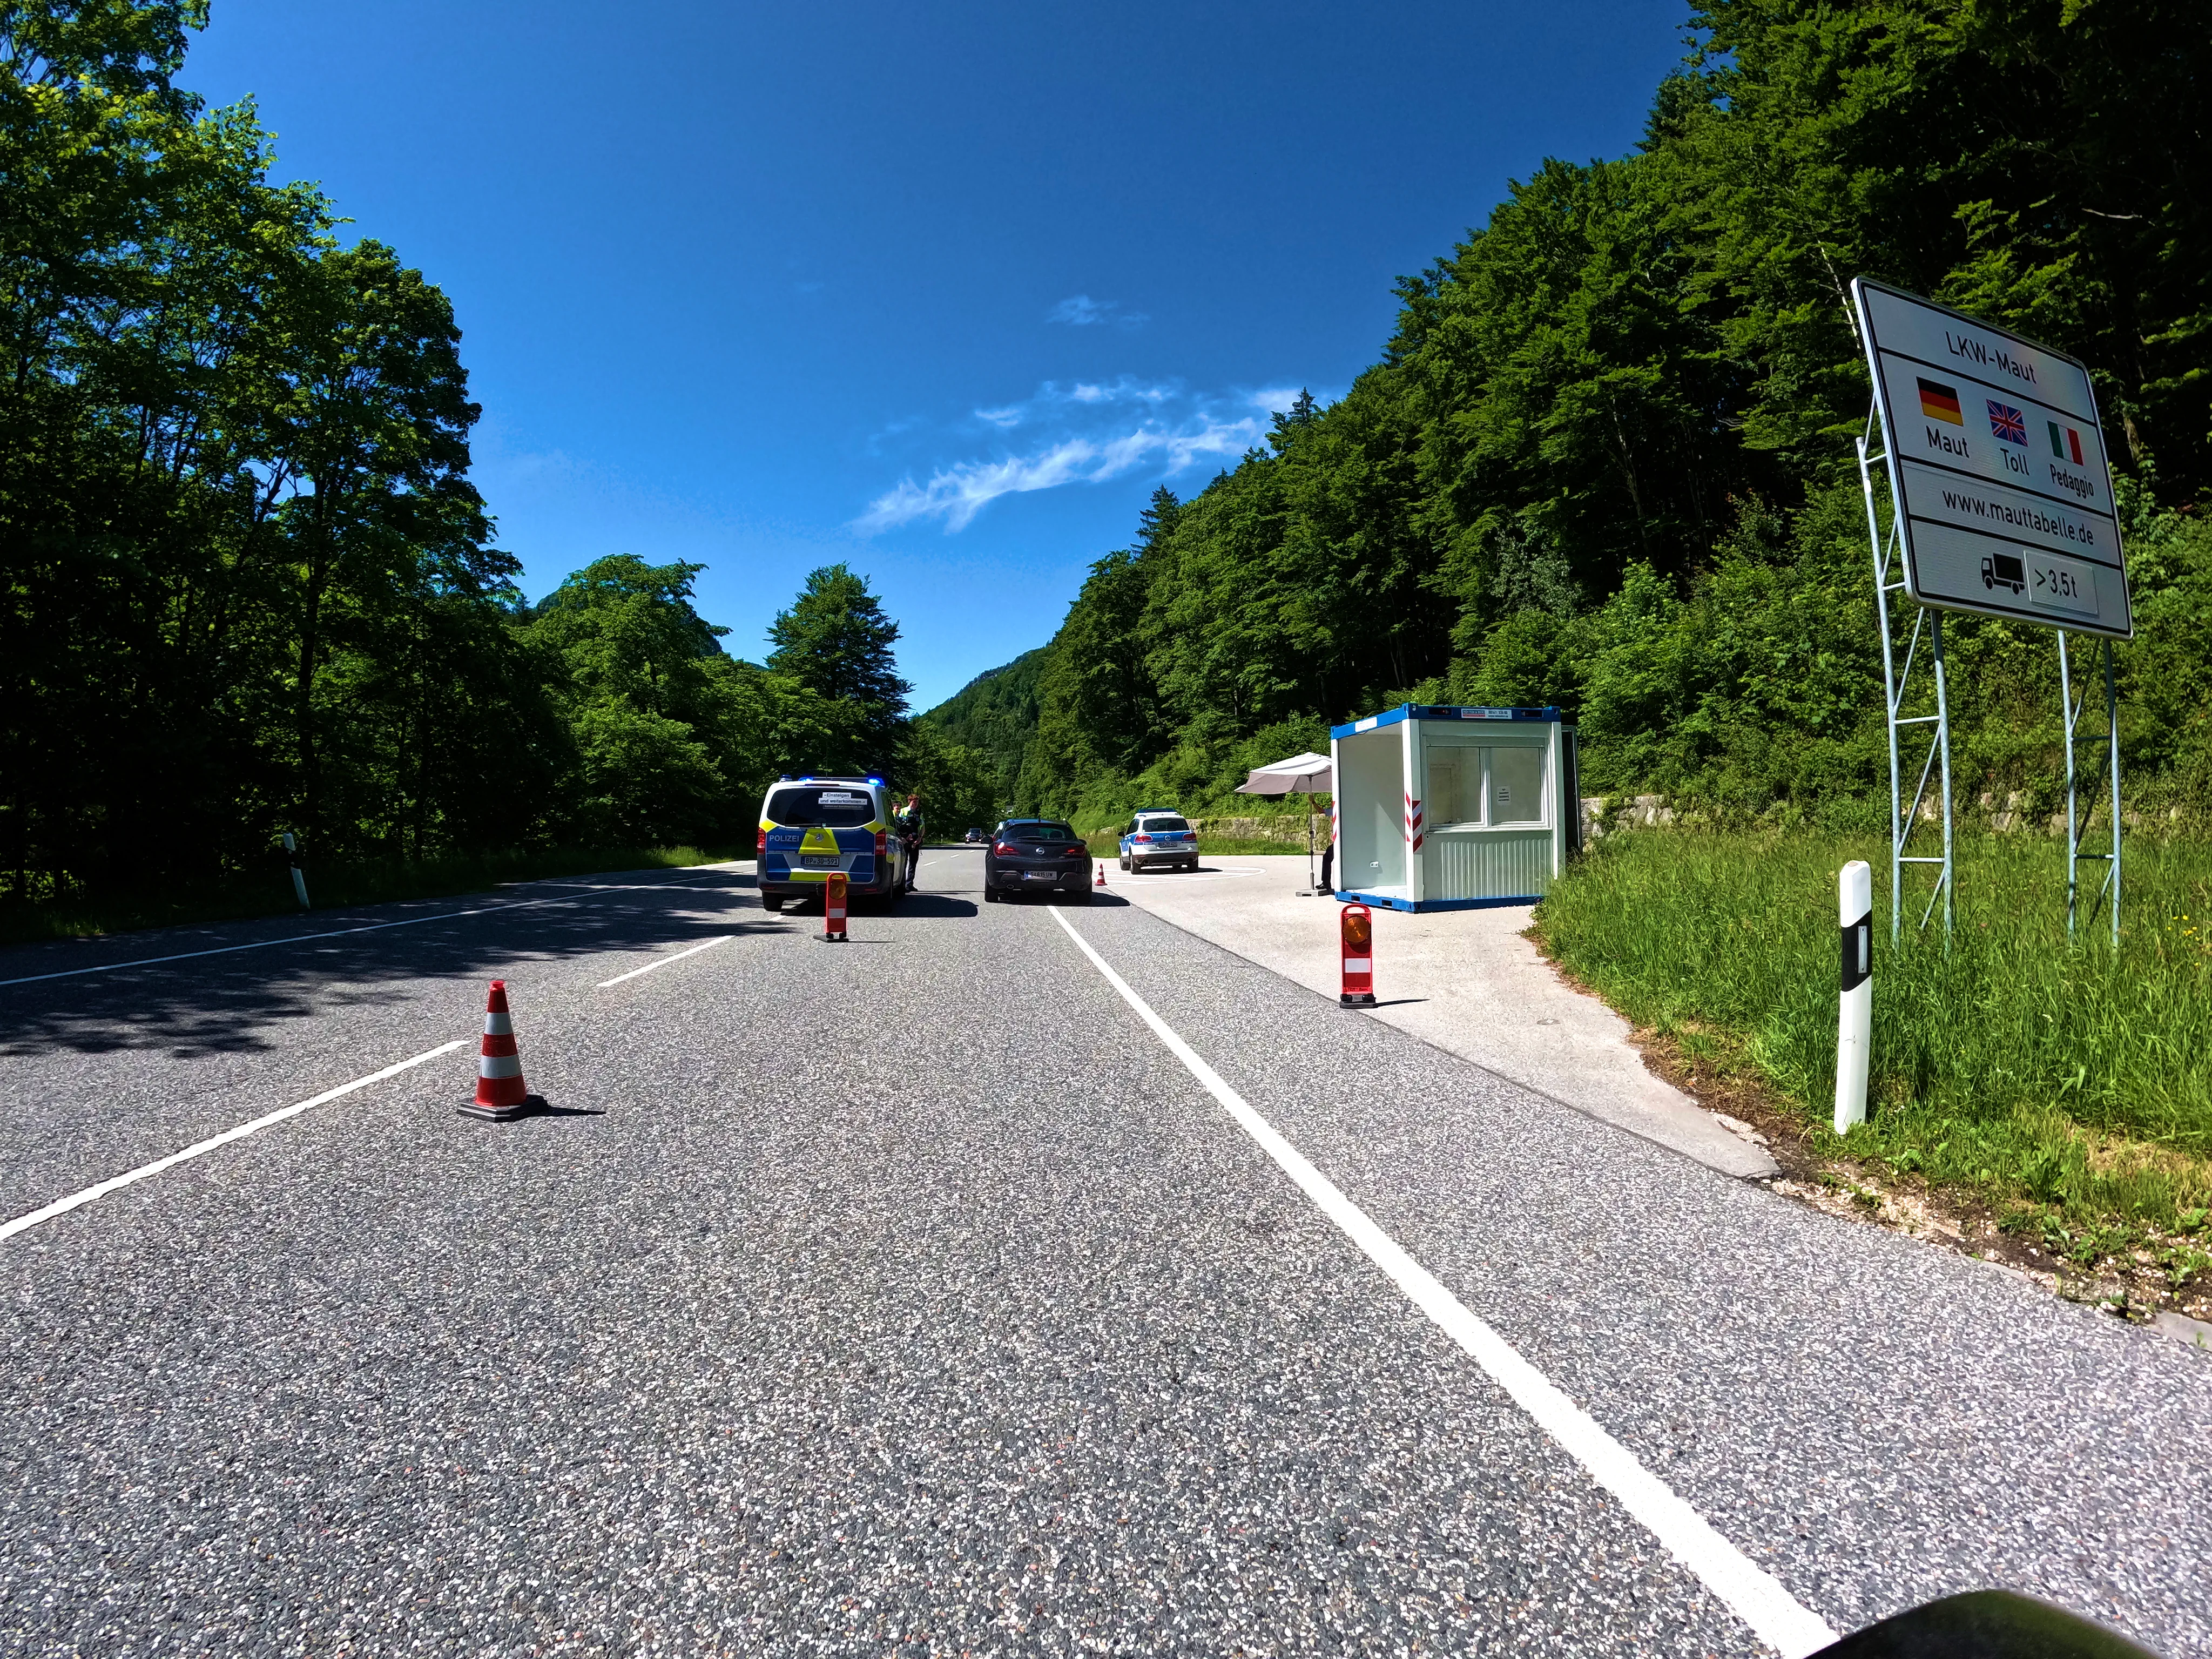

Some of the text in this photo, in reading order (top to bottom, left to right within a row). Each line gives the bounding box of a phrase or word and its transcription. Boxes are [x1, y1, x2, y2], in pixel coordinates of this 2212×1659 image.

[1945, 331, 2036, 384] LKW-Maut
[1926, 425, 1970, 458] Maut
[2000, 447, 2029, 476] Toll
[2049, 463, 2094, 499] Pedaggio
[1942, 490, 2094, 545] www.mauttabelle.de
